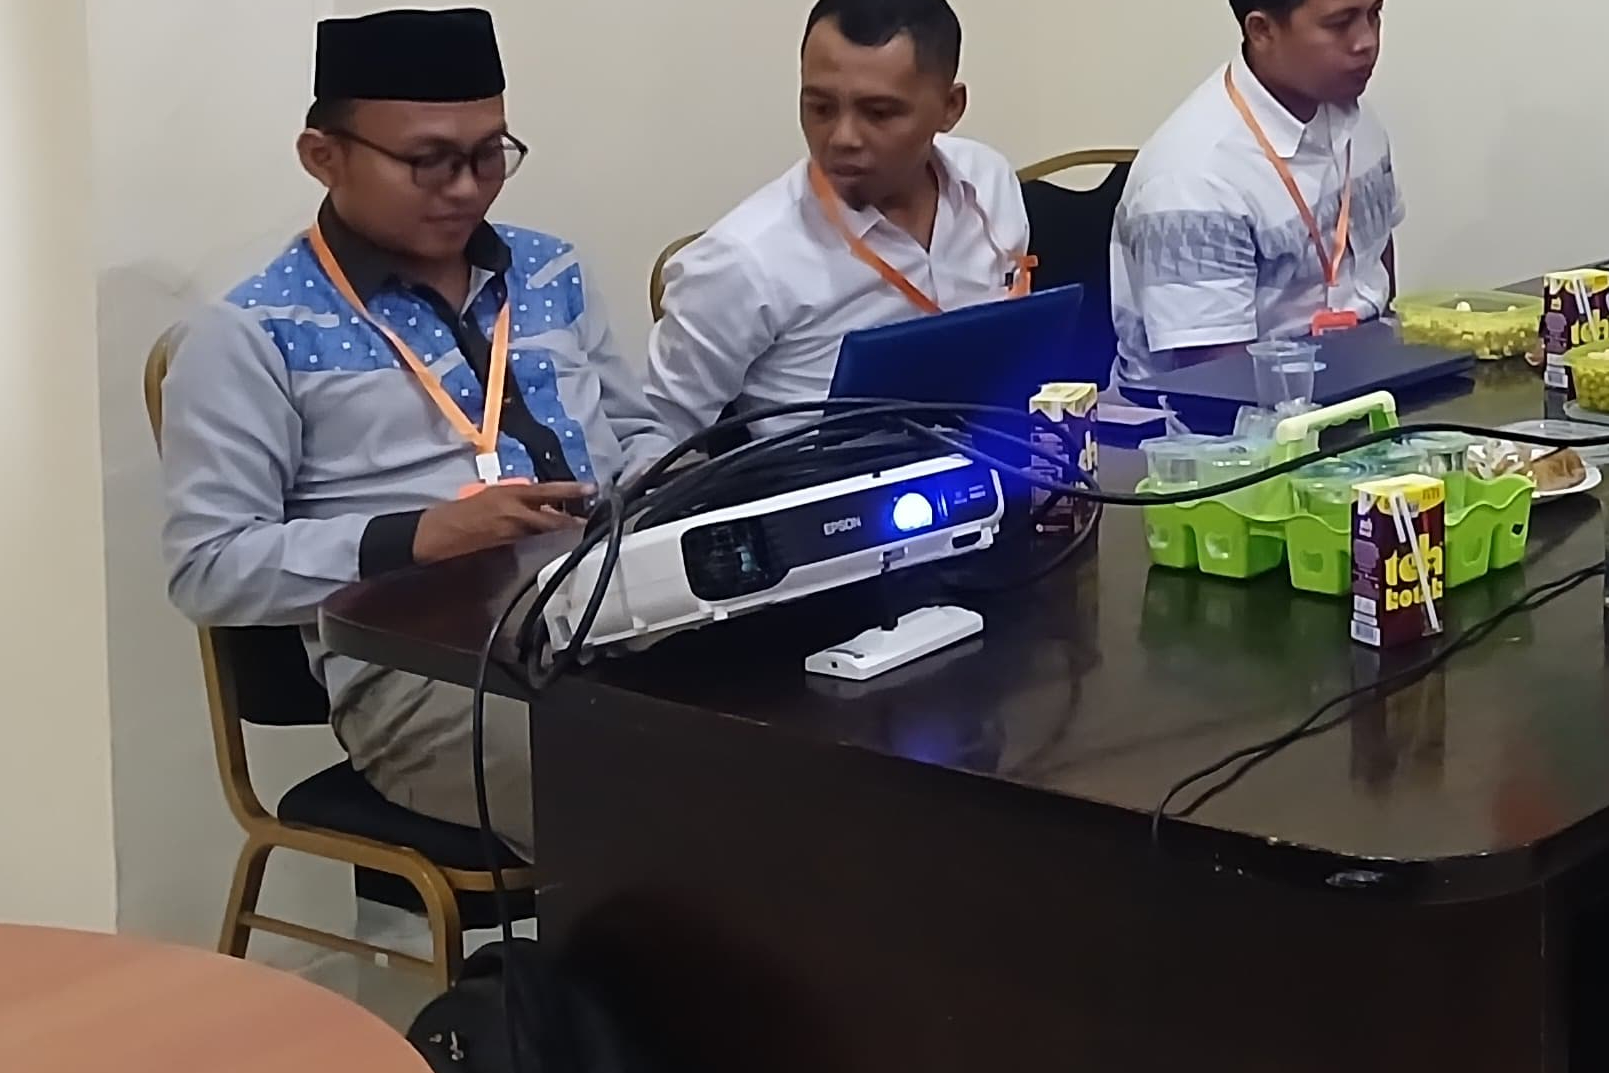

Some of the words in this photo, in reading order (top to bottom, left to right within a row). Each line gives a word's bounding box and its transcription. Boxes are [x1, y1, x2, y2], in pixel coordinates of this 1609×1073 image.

[824, 517, 861, 535] EPSON
[1384, 533, 1443, 587] teh
[1385, 576, 1444, 612] kotk
